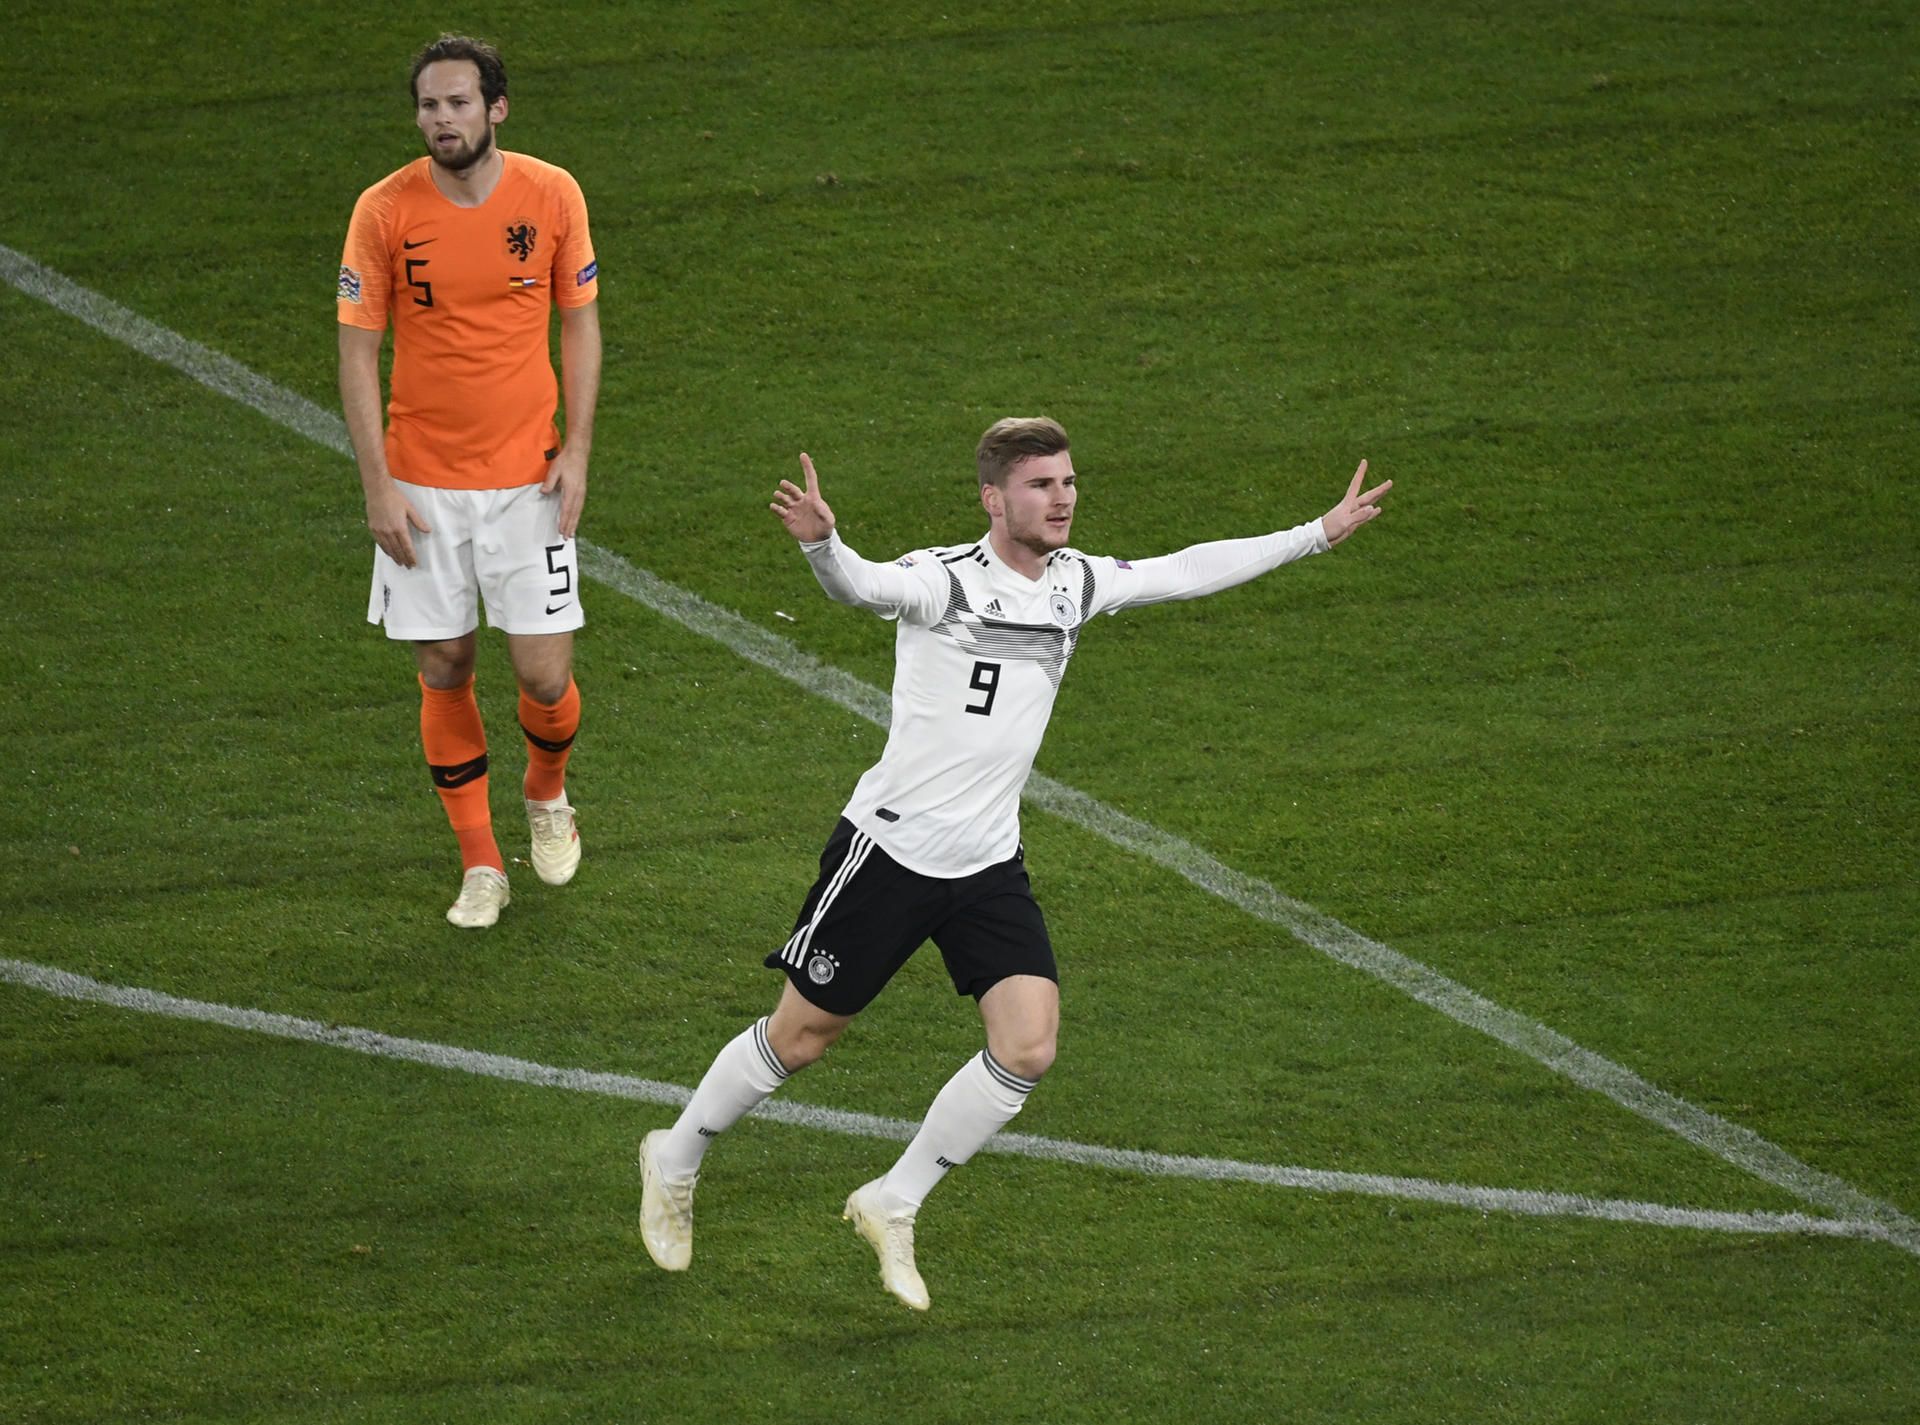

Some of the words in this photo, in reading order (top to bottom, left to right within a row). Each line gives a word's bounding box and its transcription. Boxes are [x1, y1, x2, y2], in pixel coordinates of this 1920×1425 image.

[406, 259, 433, 307] 5
[545, 544, 570, 596] 5
[965, 661, 1001, 716] 9
[935, 1156, 953, 1169] DF
